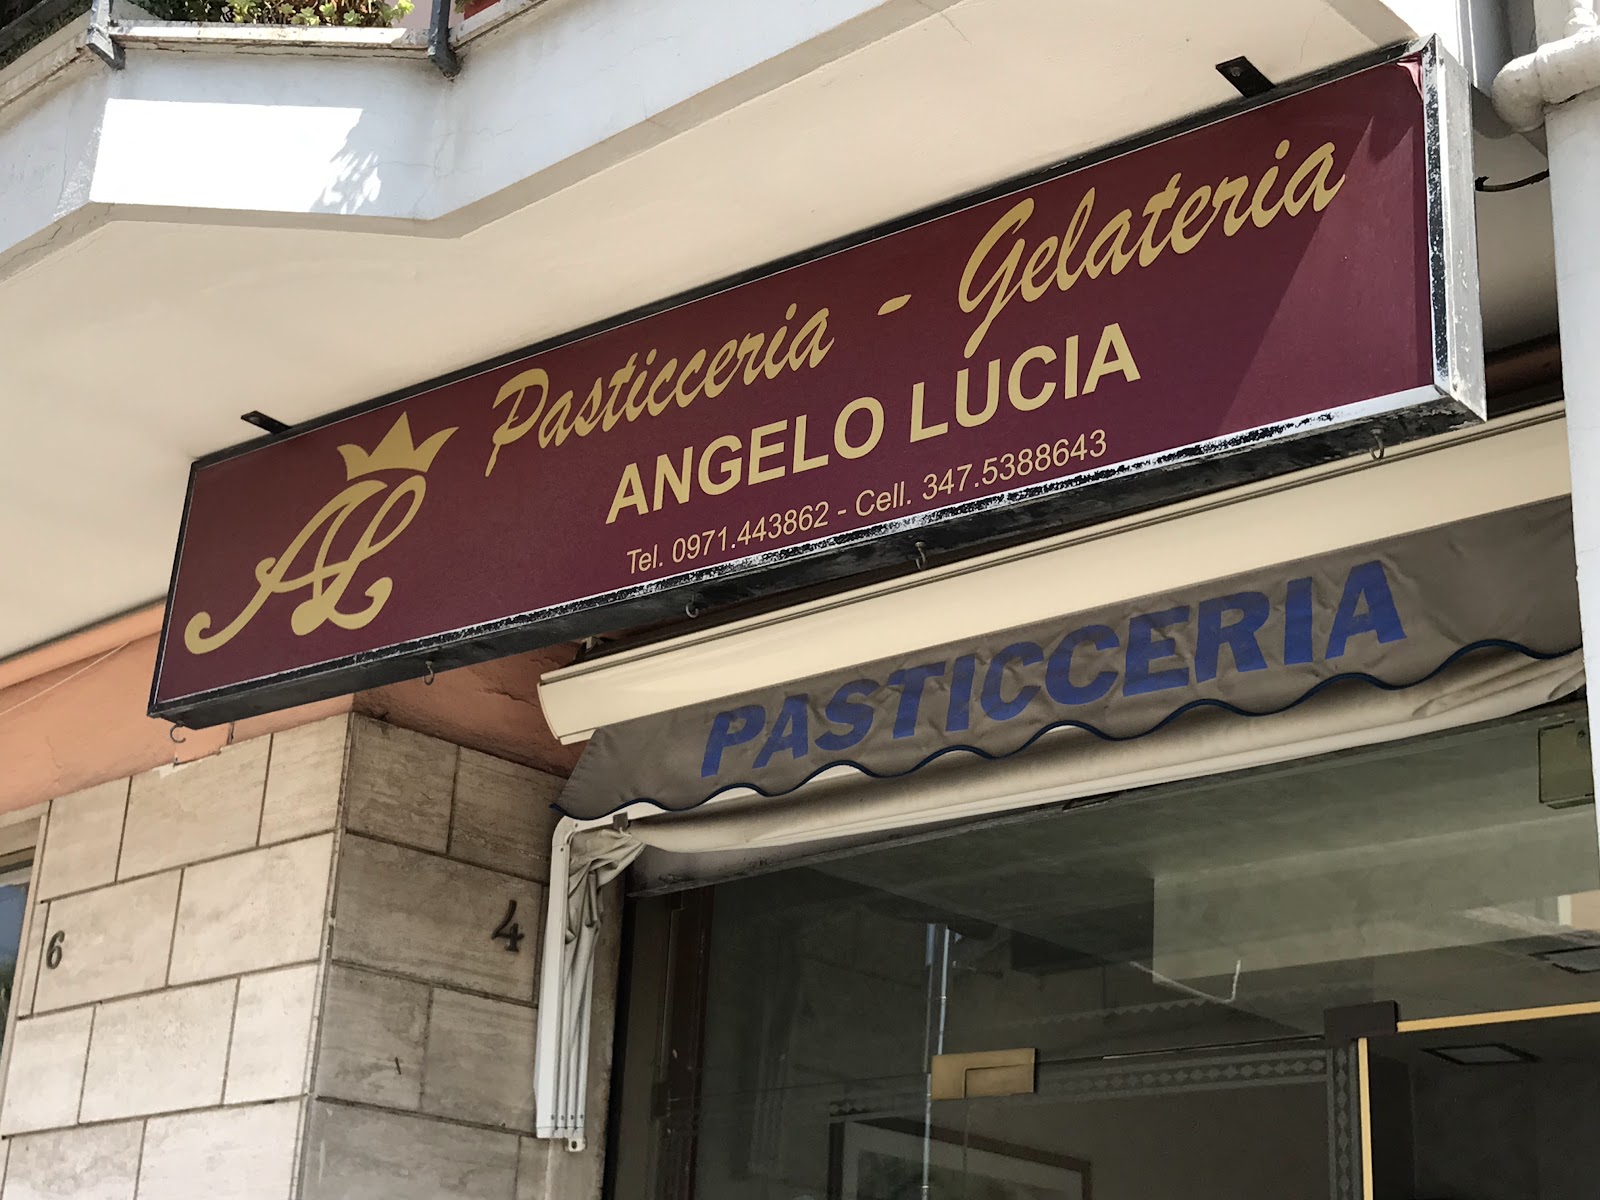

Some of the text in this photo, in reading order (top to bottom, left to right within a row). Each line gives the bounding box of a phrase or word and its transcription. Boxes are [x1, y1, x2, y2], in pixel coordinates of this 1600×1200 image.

[484, 139, 1346, 478] Pasticceria - Gelateria
[605, 322, 1141, 525] ANGELO LUCIA
[626, 543, 664, 575] Tel.
[672, 501, 830, 563] 0971.443862
[855, 480, 912, 517] Cell.
[922, 429, 1108, 501] 347.5388643
[700, 559, 1408, 779] PASTICCERIA
[45, 930, 66, 970] 6
[491, 900, 525, 953] 4
